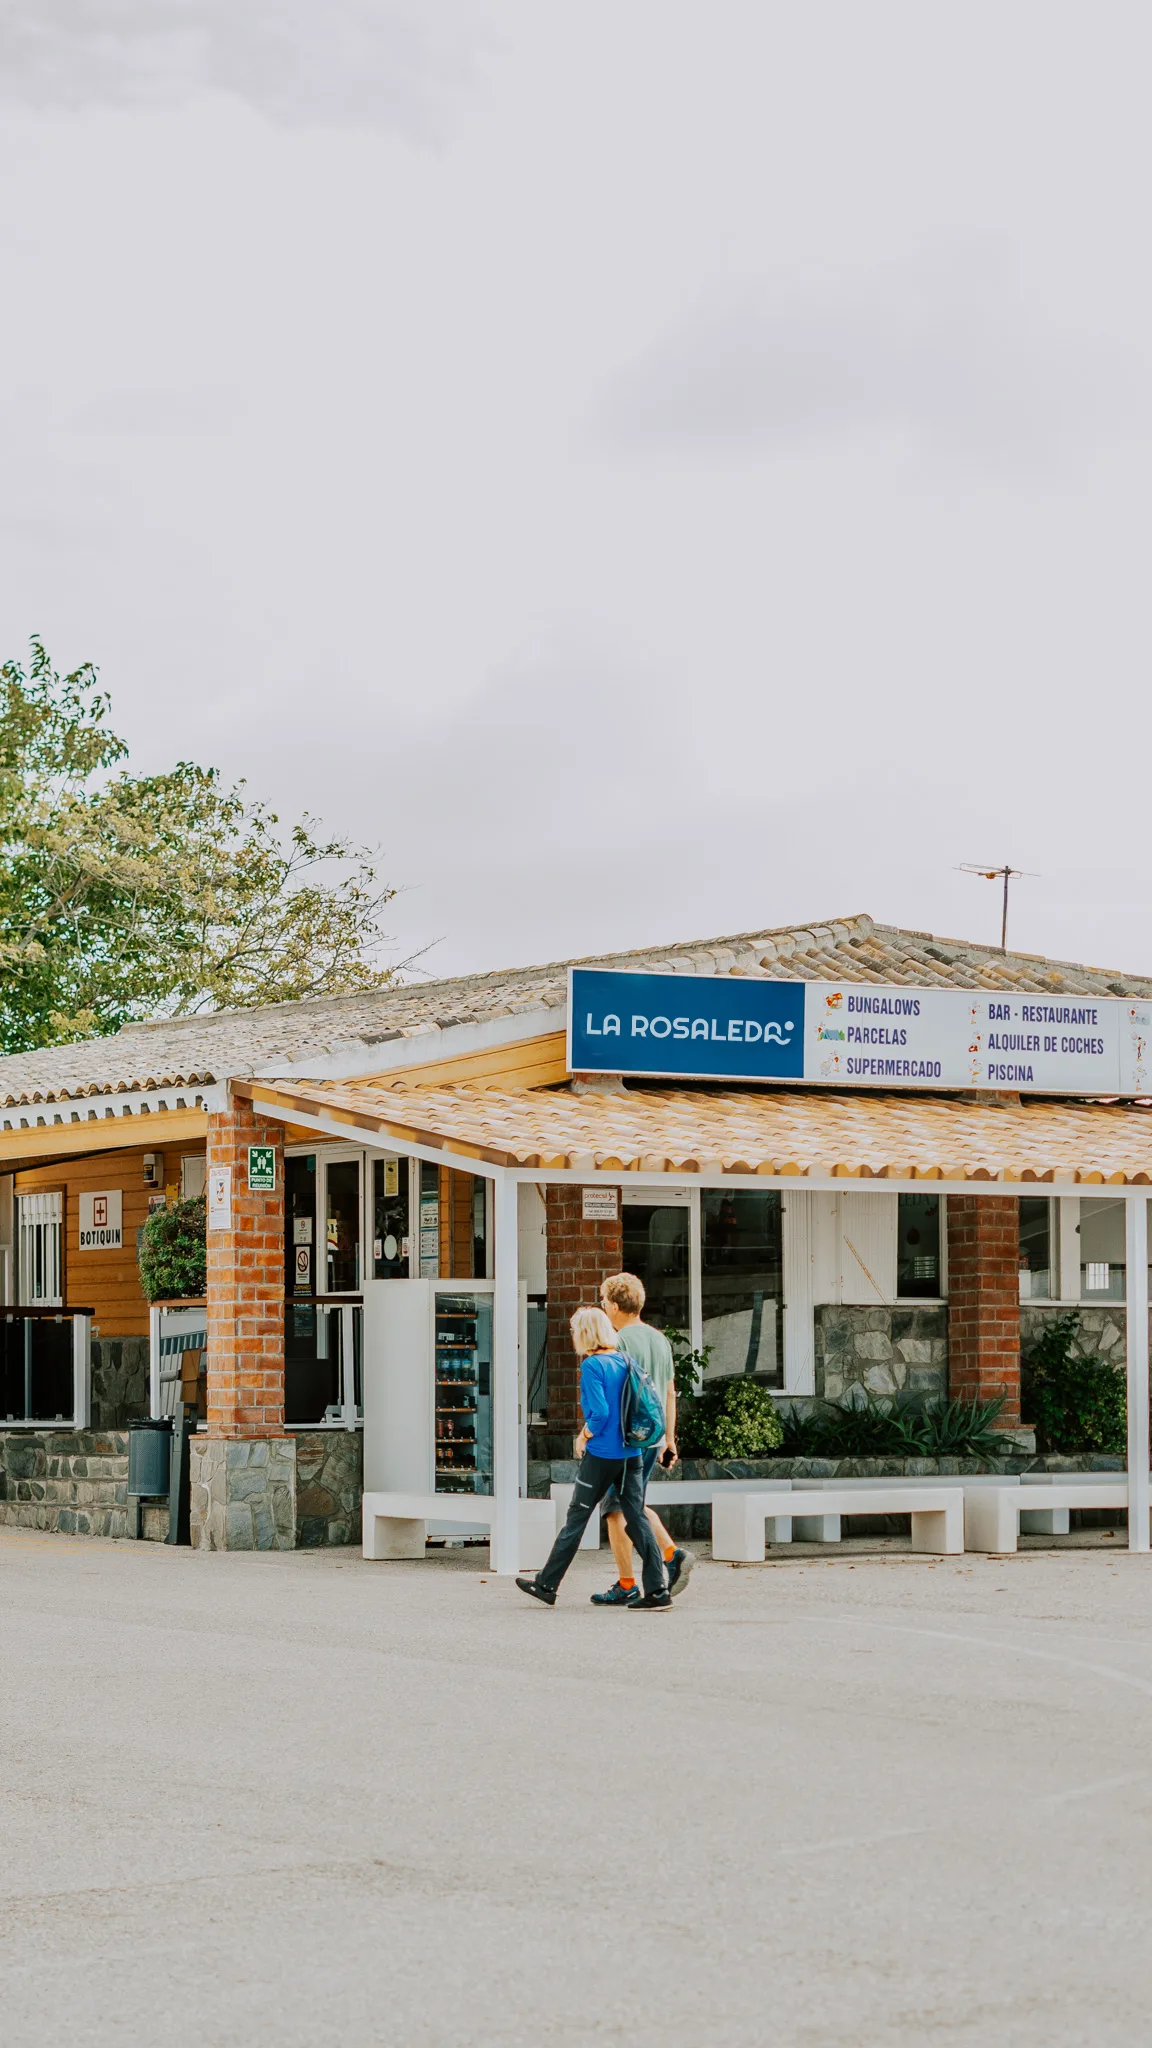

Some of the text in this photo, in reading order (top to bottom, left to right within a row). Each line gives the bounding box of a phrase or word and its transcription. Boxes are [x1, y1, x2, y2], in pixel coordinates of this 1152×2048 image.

[847, 996, 921, 1016] BUNGALOWS
[988, 1004, 1011, 1021] BAR
[1022, 1006, 1098, 1025] RESTAURANTE
[587, 1013, 793, 1045] LA ROSALEDA
[847, 1027, 907, 1046] PARCELAS
[988, 1033, 1104, 1055] ALQUILER DE COCHES
[847, 1057, 941, 1078] SUPERMERCADO
[988, 1064, 1033, 1081] PISCINA
[80, 1229, 121, 1245] BOTIQUIN
